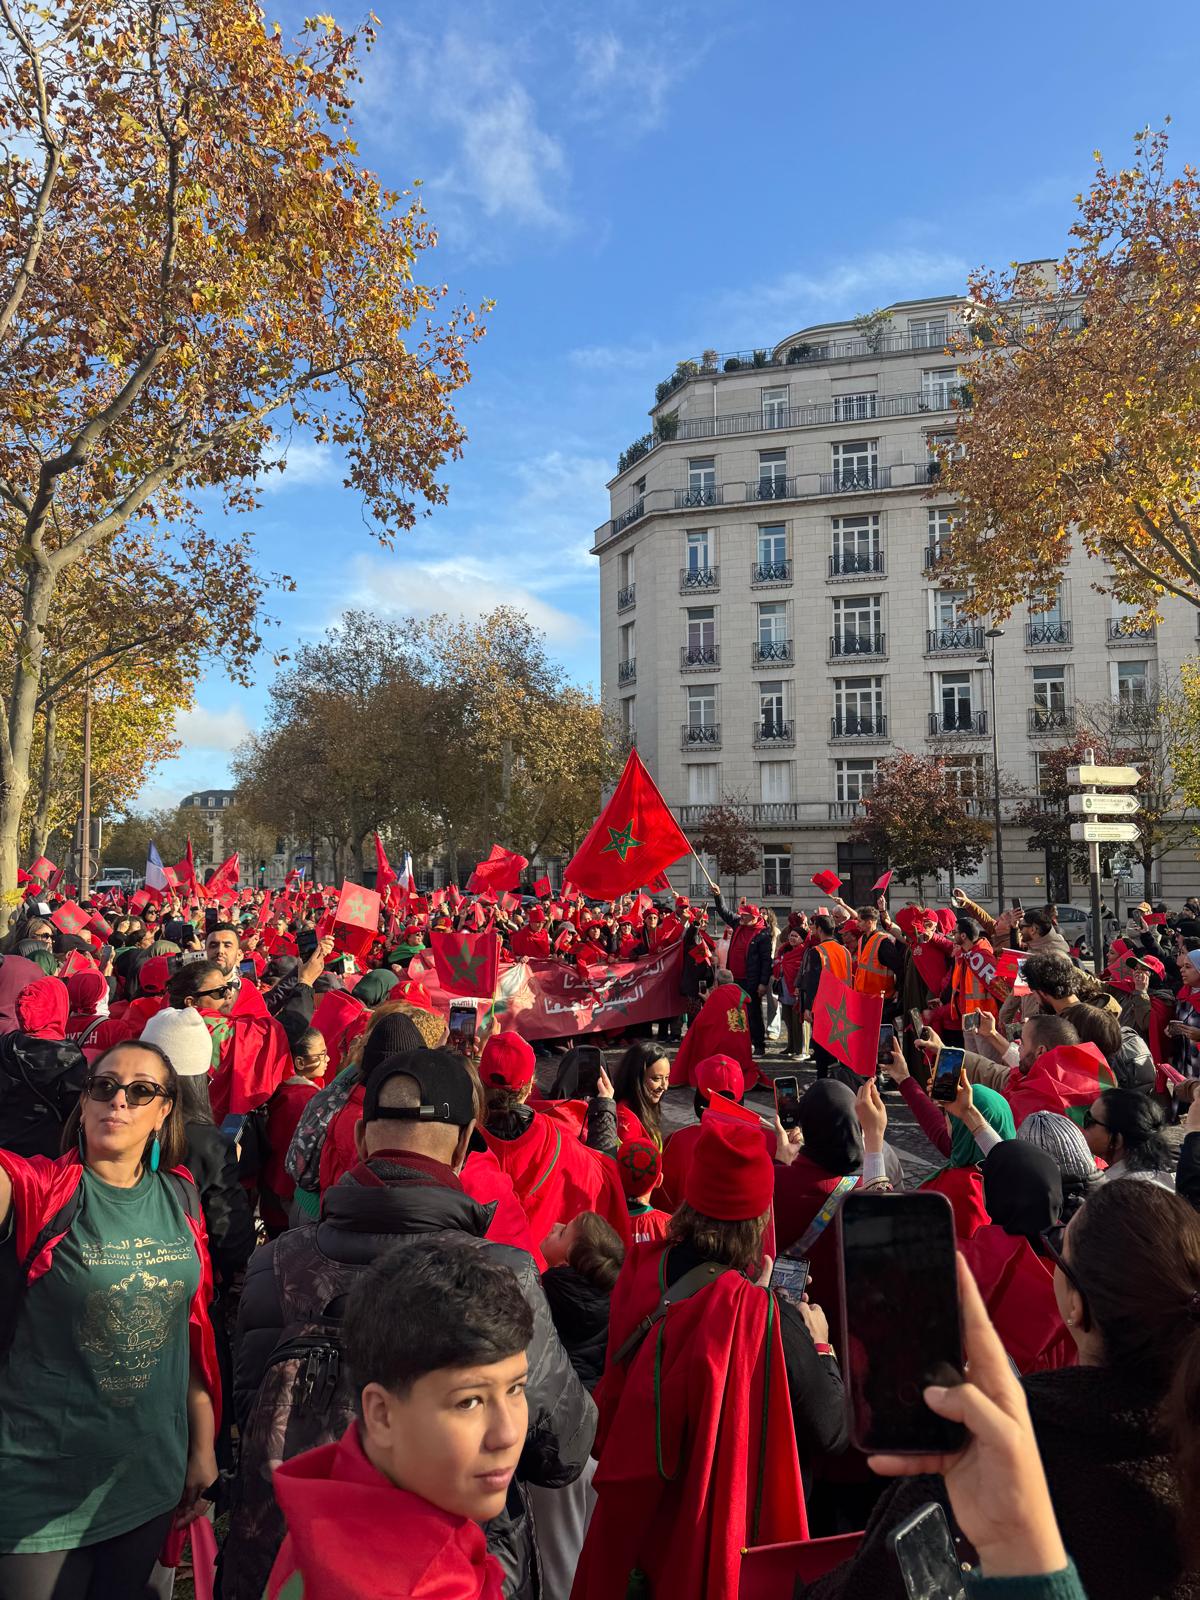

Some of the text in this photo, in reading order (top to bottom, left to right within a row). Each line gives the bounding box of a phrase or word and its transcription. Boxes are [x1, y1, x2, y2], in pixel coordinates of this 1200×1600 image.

[82, 1246, 192, 1260] ROYAUME DU MAROC
[82, 1258, 130, 1266] KINGDOM
[145, 1253, 192, 1266] MOROCCO
